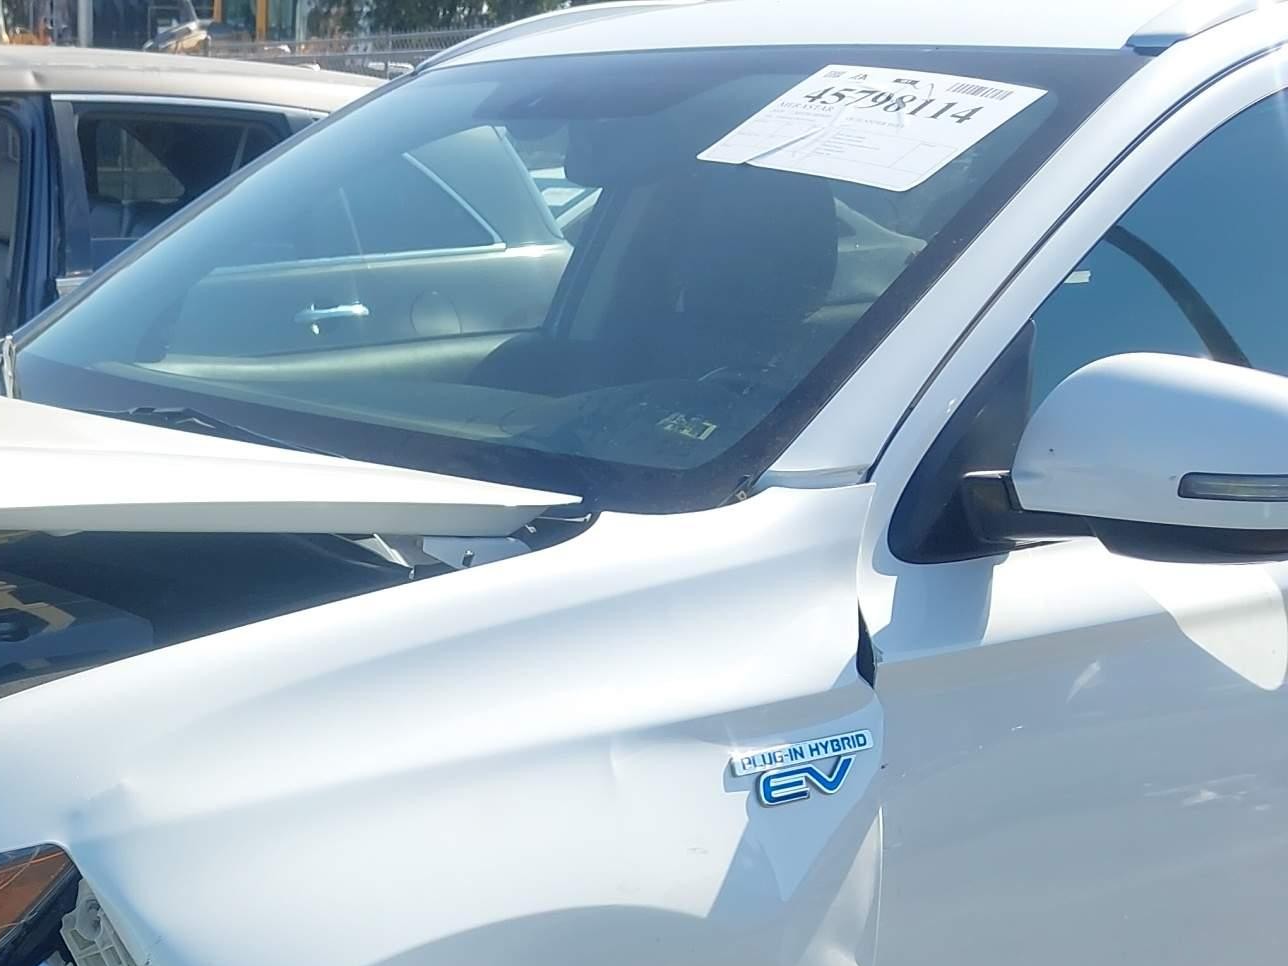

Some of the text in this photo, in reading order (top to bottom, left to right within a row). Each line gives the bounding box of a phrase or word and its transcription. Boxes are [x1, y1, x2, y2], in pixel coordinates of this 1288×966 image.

[804, 86, 985, 125] 45798114
[741, 733, 868, 770] PLUG-IN HYBRID
[762, 756, 854, 804] EV
